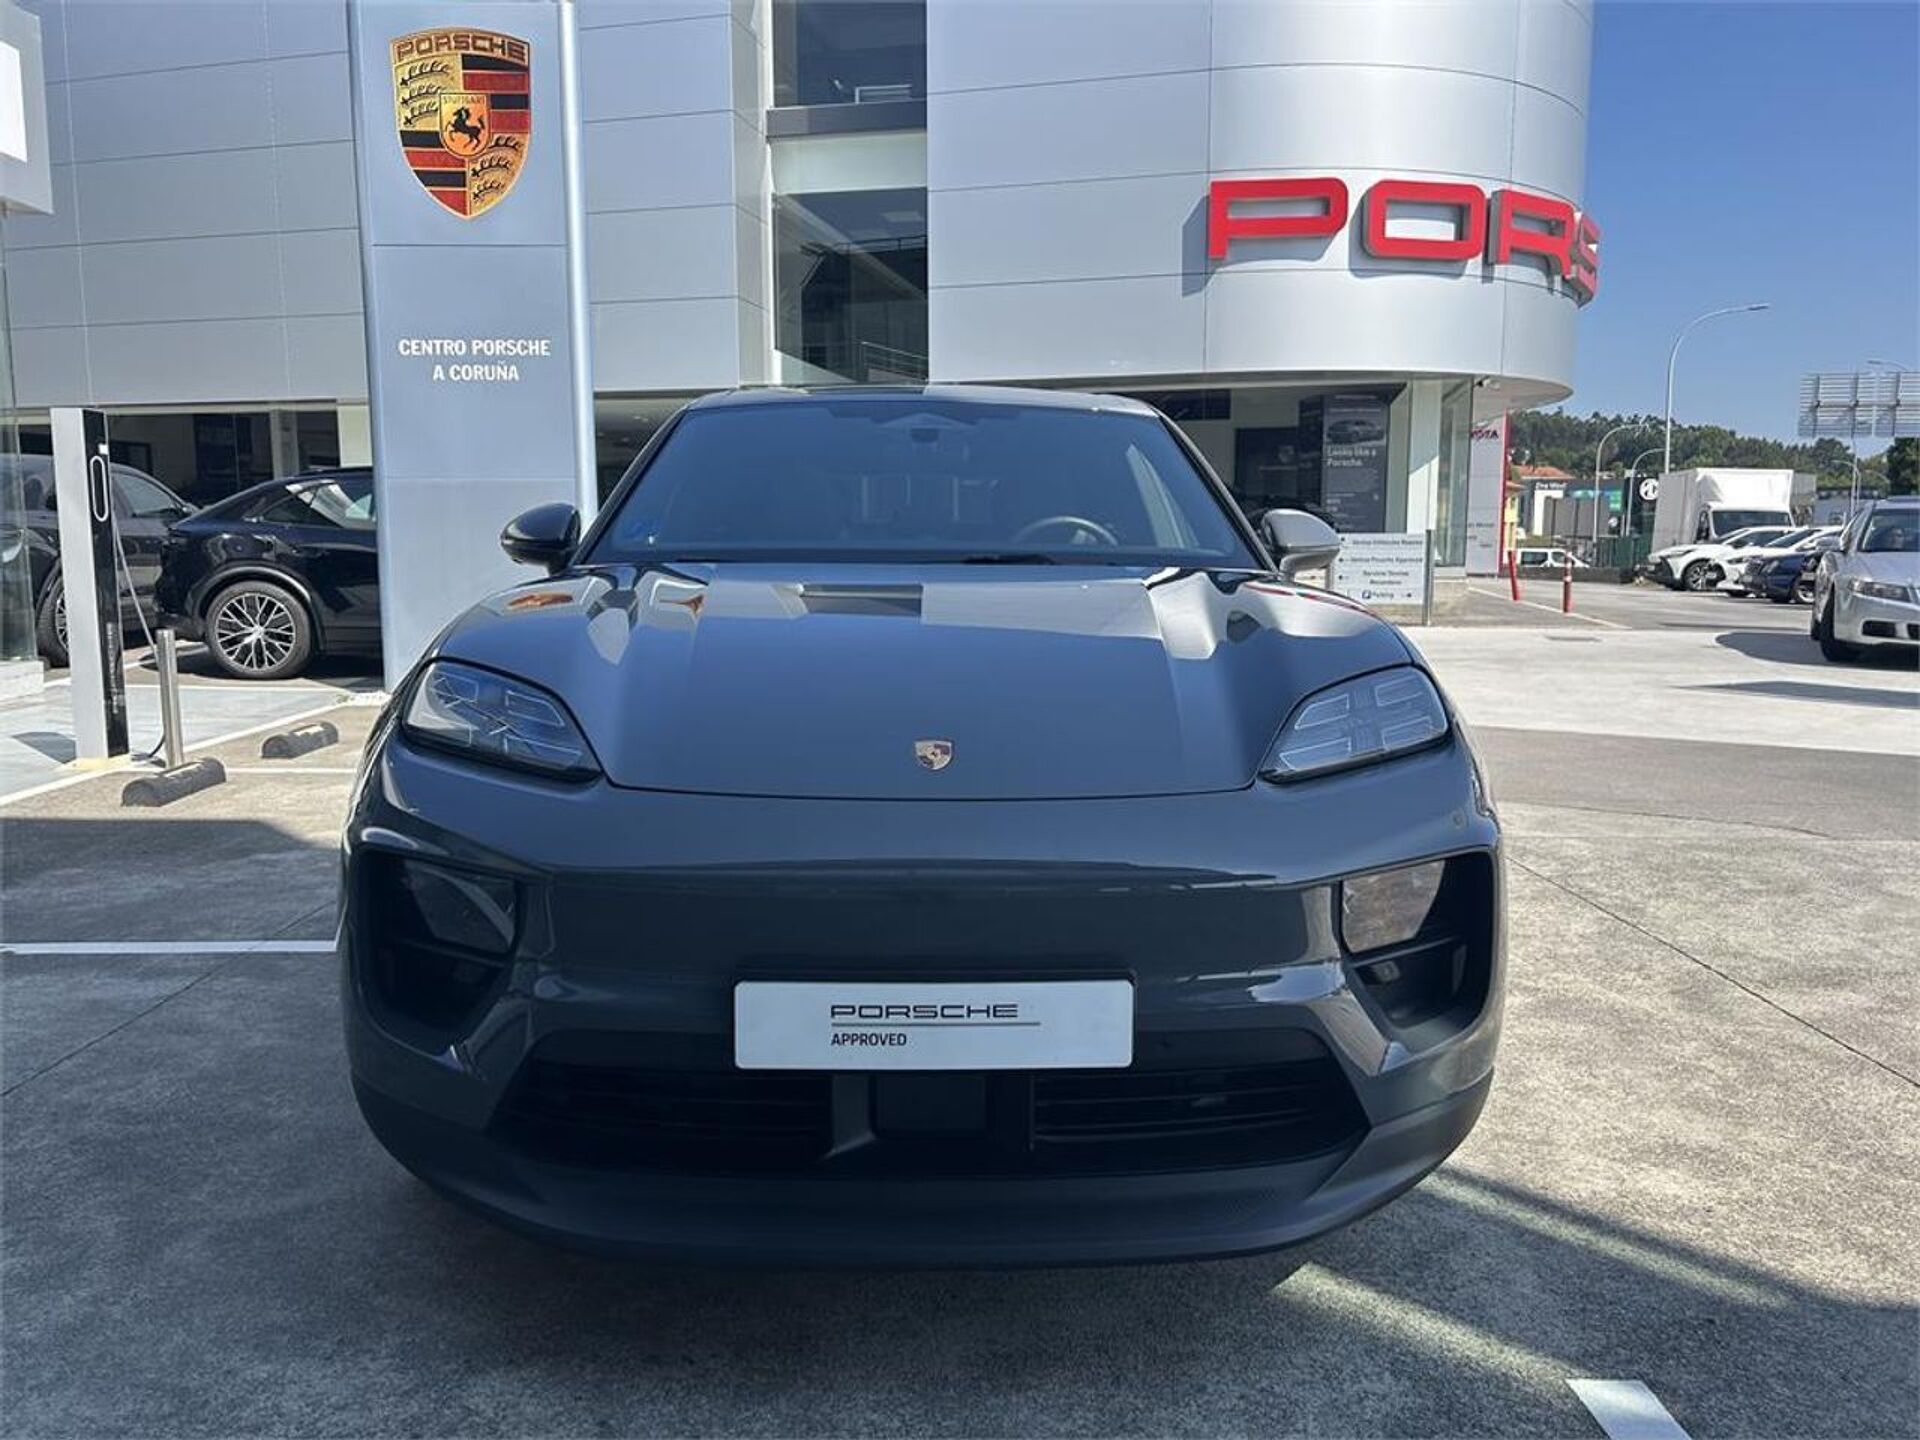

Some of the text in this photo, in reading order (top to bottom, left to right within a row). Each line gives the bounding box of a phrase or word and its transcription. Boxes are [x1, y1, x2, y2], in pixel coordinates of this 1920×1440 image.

[392, 34, 526, 62] PORSCHE
[1208, 177, 1600, 296] PORS
[399, 339, 552, 356] CENTRO PORSCHE
[433, 360, 520, 381] A CORUÑA
[831, 1004, 1018, 1019] PORSCHE
[831, 1032, 907, 1046] APPROVED
